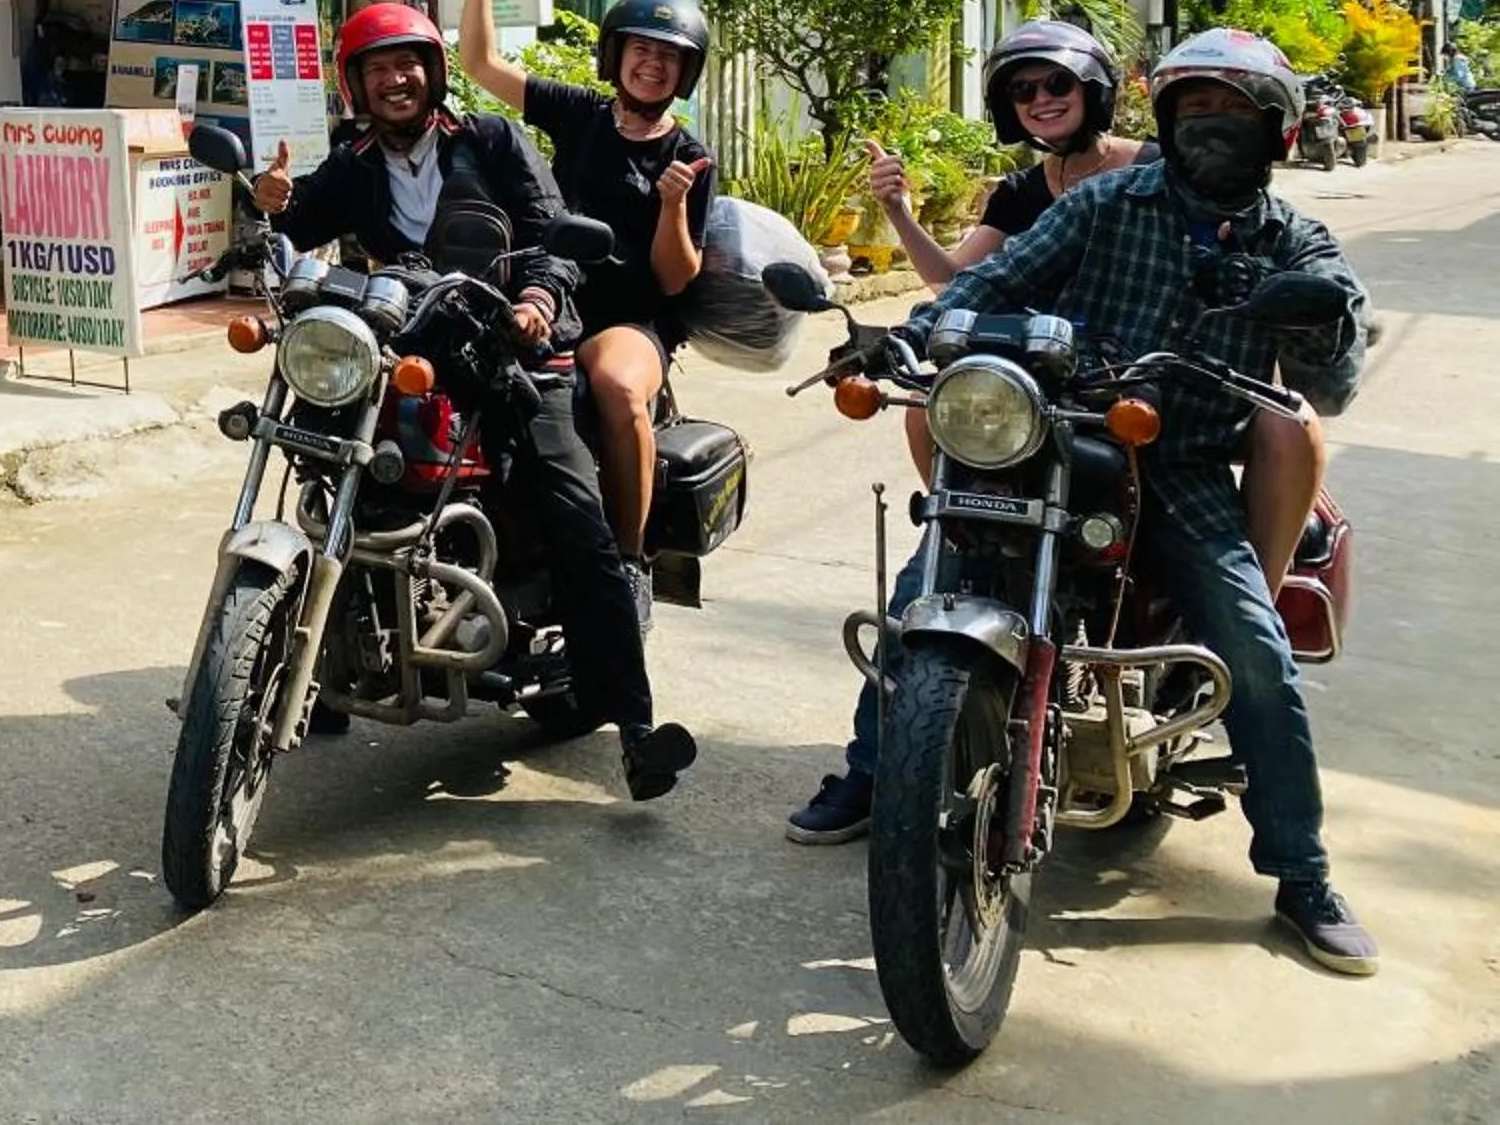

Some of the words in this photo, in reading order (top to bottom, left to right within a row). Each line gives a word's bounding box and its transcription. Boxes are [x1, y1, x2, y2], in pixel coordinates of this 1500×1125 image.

[160, 158, 180, 171] MRS
[0, 152, 112, 240] LAUNDRY
[7, 239, 116, 276] 1KG/1USD
[11, 273, 55, 304] BICYCLE:
[57, 279, 113, 310] 1USD/1DAY
[8, 308, 67, 342] MOTORBIKE:
[283, 430, 332, 450] HONDA
[957, 496, 1018, 511] HONDA
